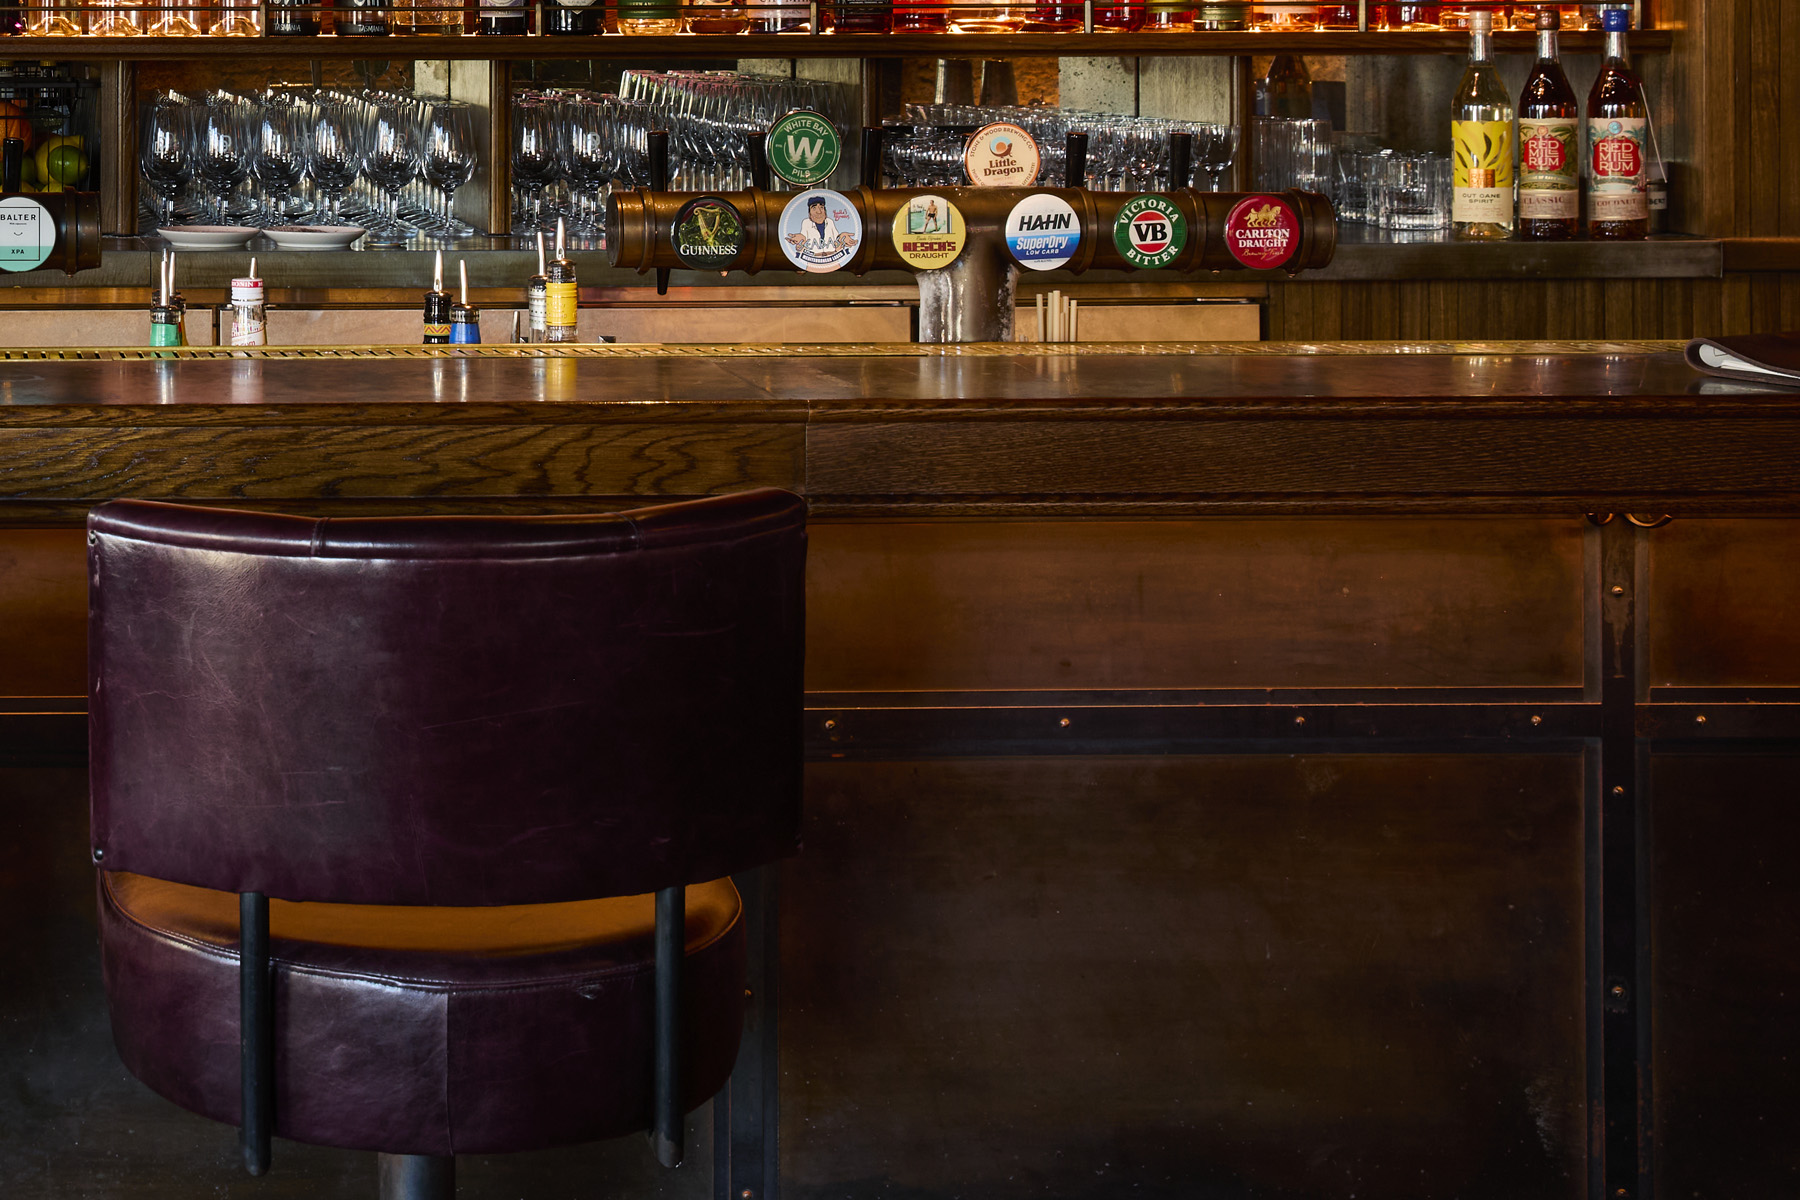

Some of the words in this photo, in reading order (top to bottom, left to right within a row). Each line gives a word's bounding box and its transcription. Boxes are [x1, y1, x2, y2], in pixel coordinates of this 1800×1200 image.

[274, 23, 301, 32] TASMANIA
[359, 24, 384, 32] TASMANIA
[784, 119, 811, 133] WHITE
[812, 121, 829, 137] BAY
[984, 127, 1003, 138] WOOD
[1003, 127, 1028, 143] BREWING
[1528, 140, 1559, 150] RED
[1600, 142, 1633, 152] RED
[989, 159, 1017, 168] Little
[1528, 157, 1559, 166] RUM
[983, 166, 1024, 177] Dragon
[1600, 162, 1633, 172] RUM
[791, 168, 811, 178] PILS
[1523, 195, 1564, 205] CLASSIC
[1597, 199, 1636, 207] COCONUT
[1119, 198, 1180, 225] VICTORIA
[1019, 213, 1072, 231] HAHN
[1133, 223, 1168, 241] VB
[1236, 228, 1290, 239] CARLTON
[902, 240, 956, 252] RESCH'S
[1016, 235, 1069, 251] SuperDry
[1238, 239, 1288, 248] DRAUGHT
[680, 244, 737, 256] GUINNESS
[1126, 245, 1179, 266] BITTER
